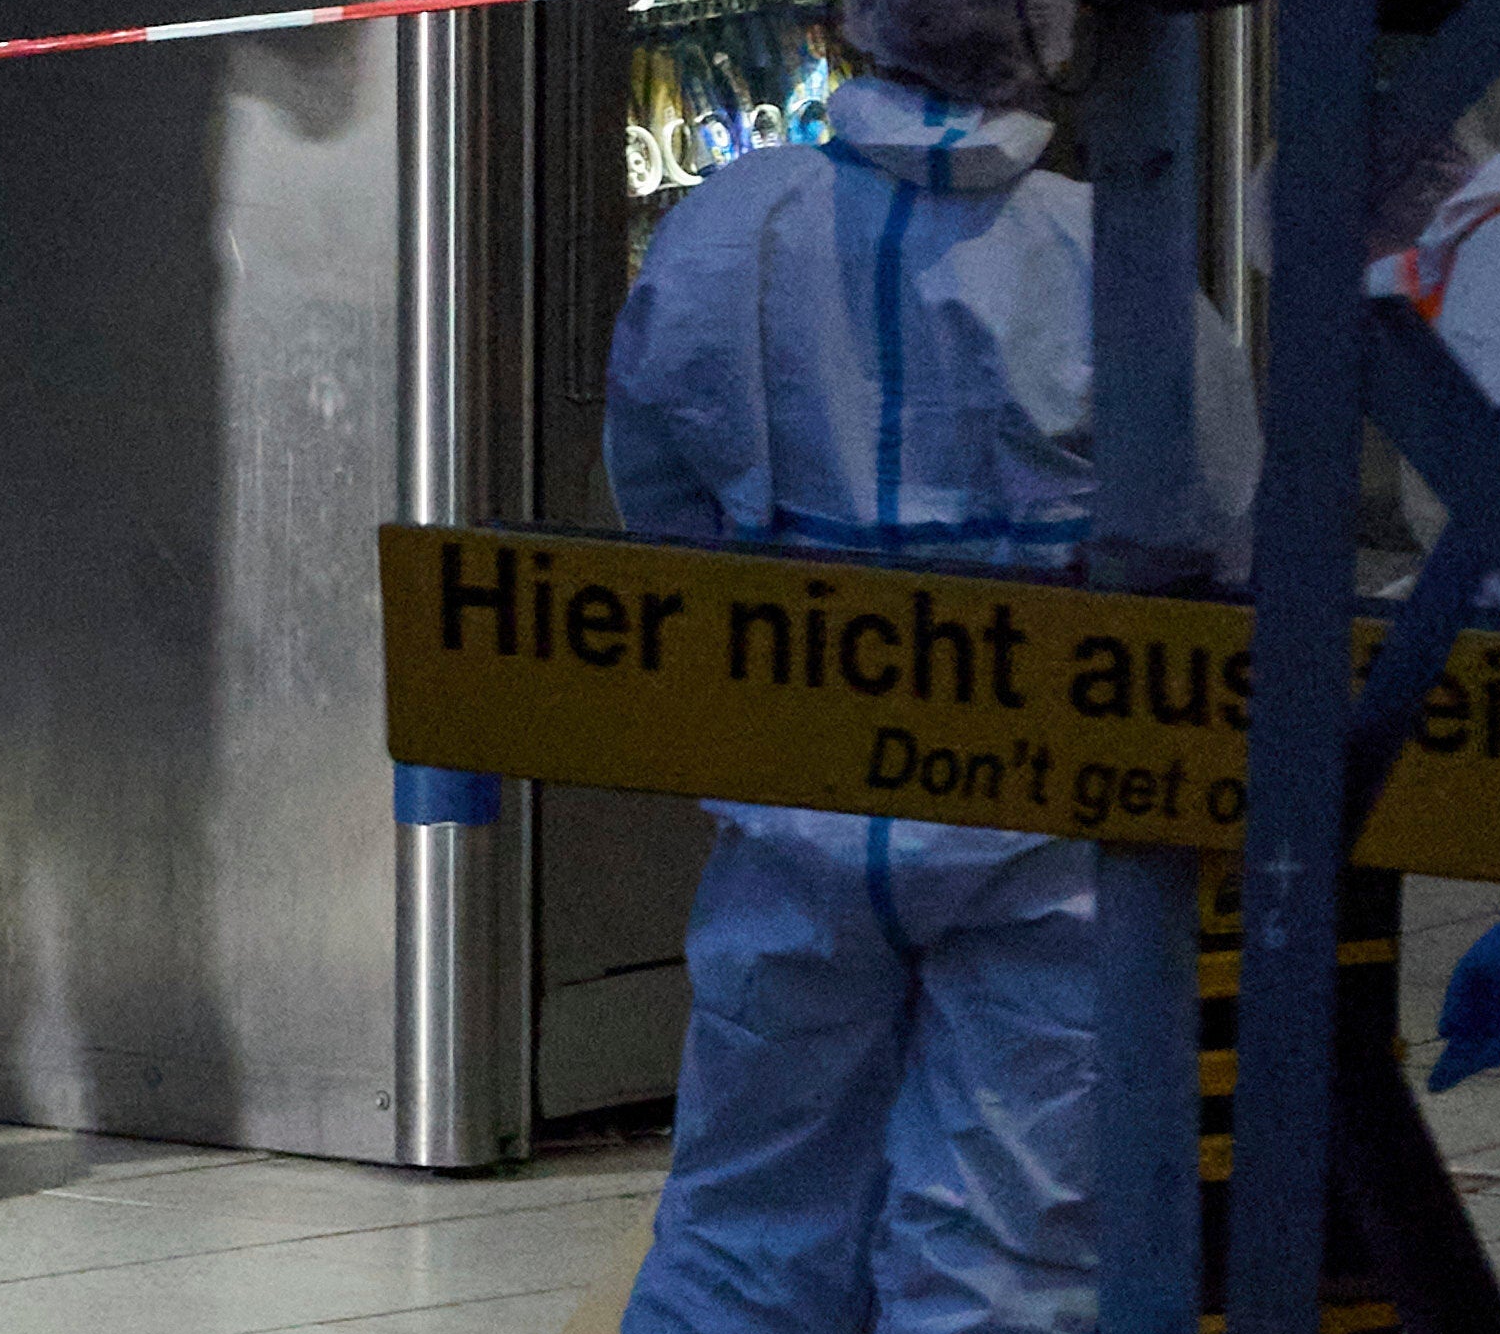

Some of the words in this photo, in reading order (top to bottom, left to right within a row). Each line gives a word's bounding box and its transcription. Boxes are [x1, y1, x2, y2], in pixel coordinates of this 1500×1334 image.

[442, 542, 684, 671] Hier
[730, 578, 1026, 709] nicht
[867, 726, 1050, 807] Don't
[1071, 753, 1181, 828] get
